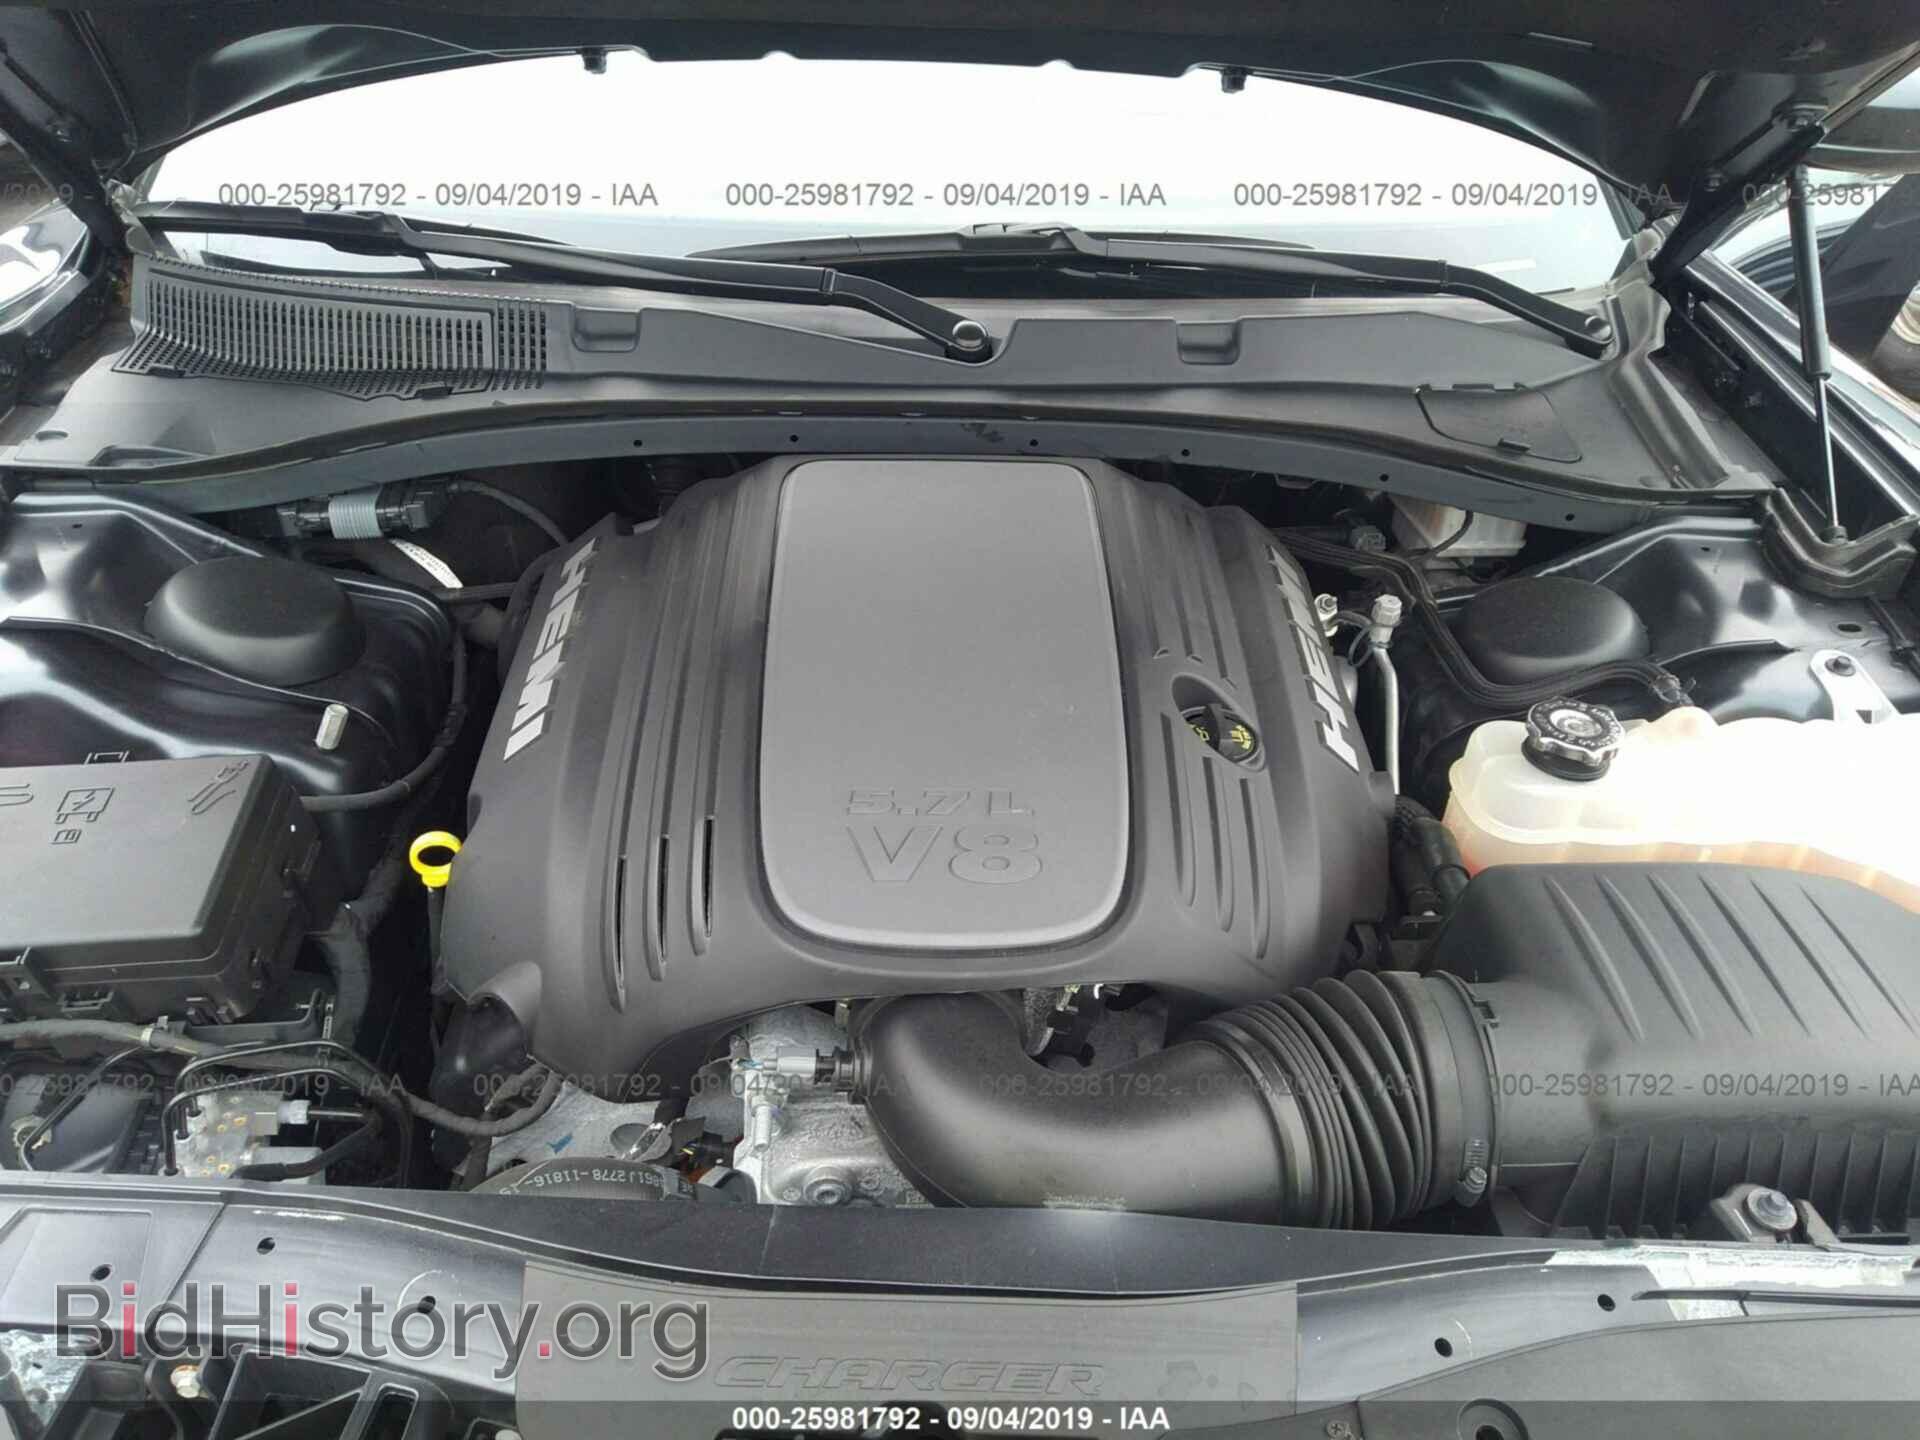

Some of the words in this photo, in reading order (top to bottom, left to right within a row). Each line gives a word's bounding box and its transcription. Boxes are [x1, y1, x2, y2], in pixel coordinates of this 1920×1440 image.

[503, 537, 597, 761] HEMI
[1270, 545, 1360, 772] HEMI
[846, 823, 1043, 884] V8
[714, 1356, 1104, 1396] CHARGER
